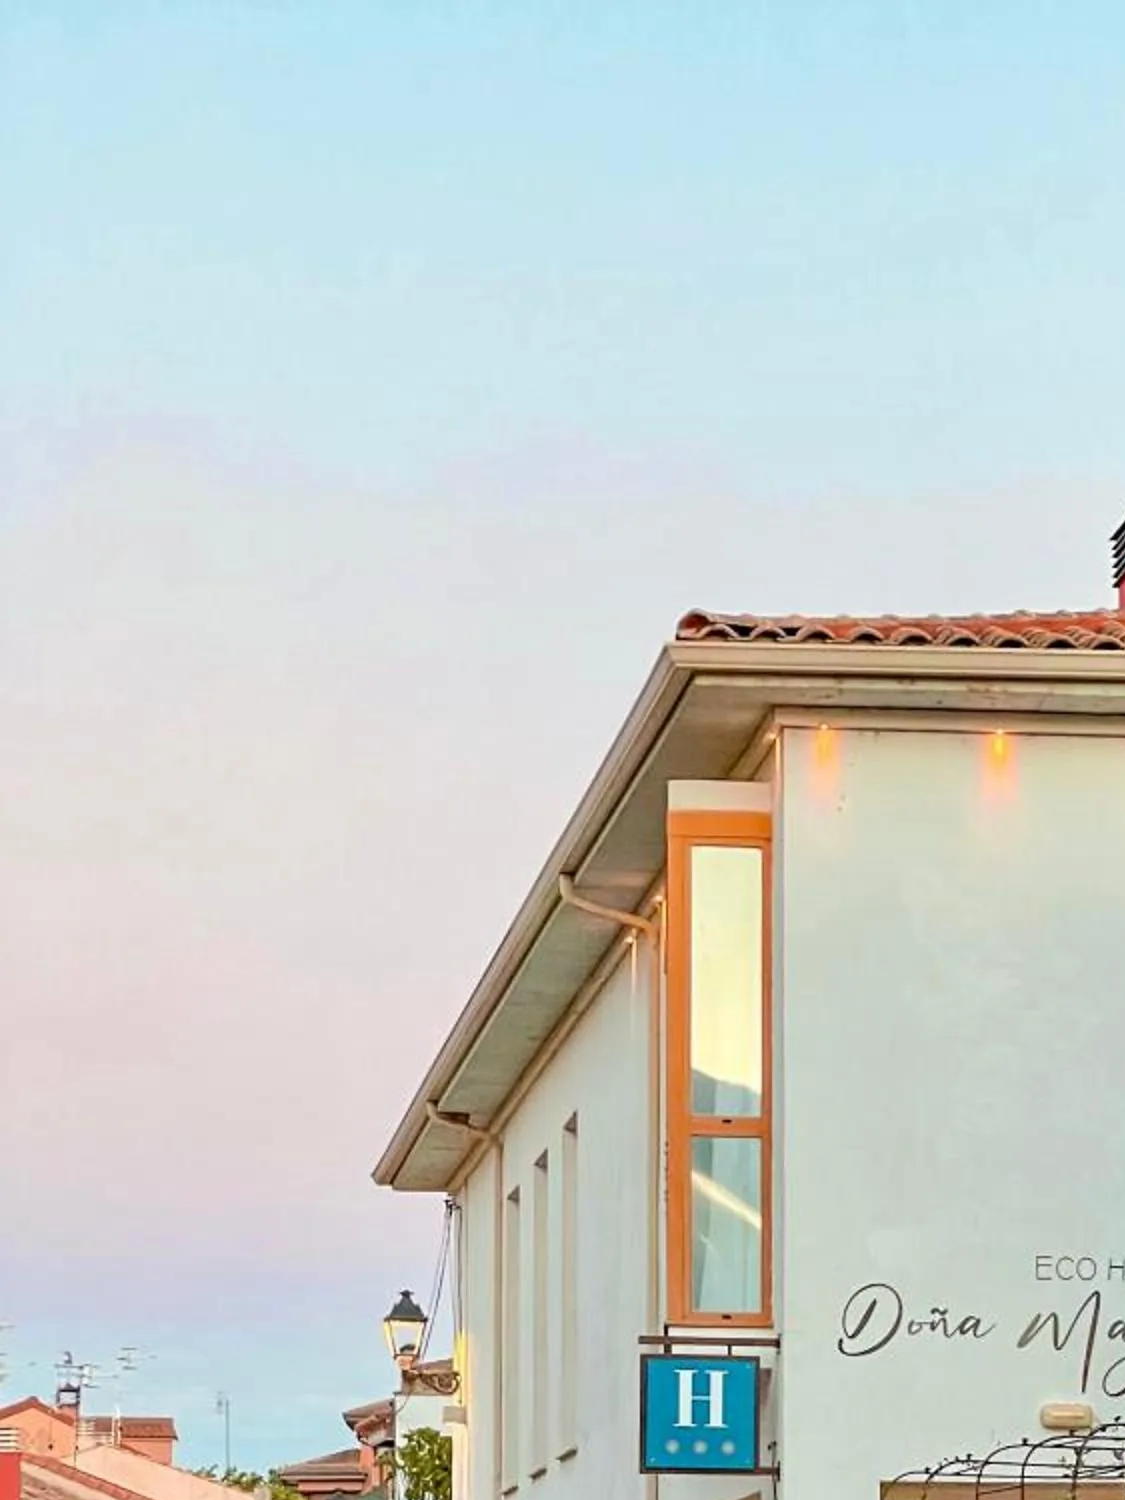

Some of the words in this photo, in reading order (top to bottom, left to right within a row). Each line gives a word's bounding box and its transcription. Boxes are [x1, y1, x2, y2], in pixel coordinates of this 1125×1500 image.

[1034, 1255, 1098, 1282] ECO
[837, 1283, 997, 1357] Doña
[672, 1369, 729, 1429] H
